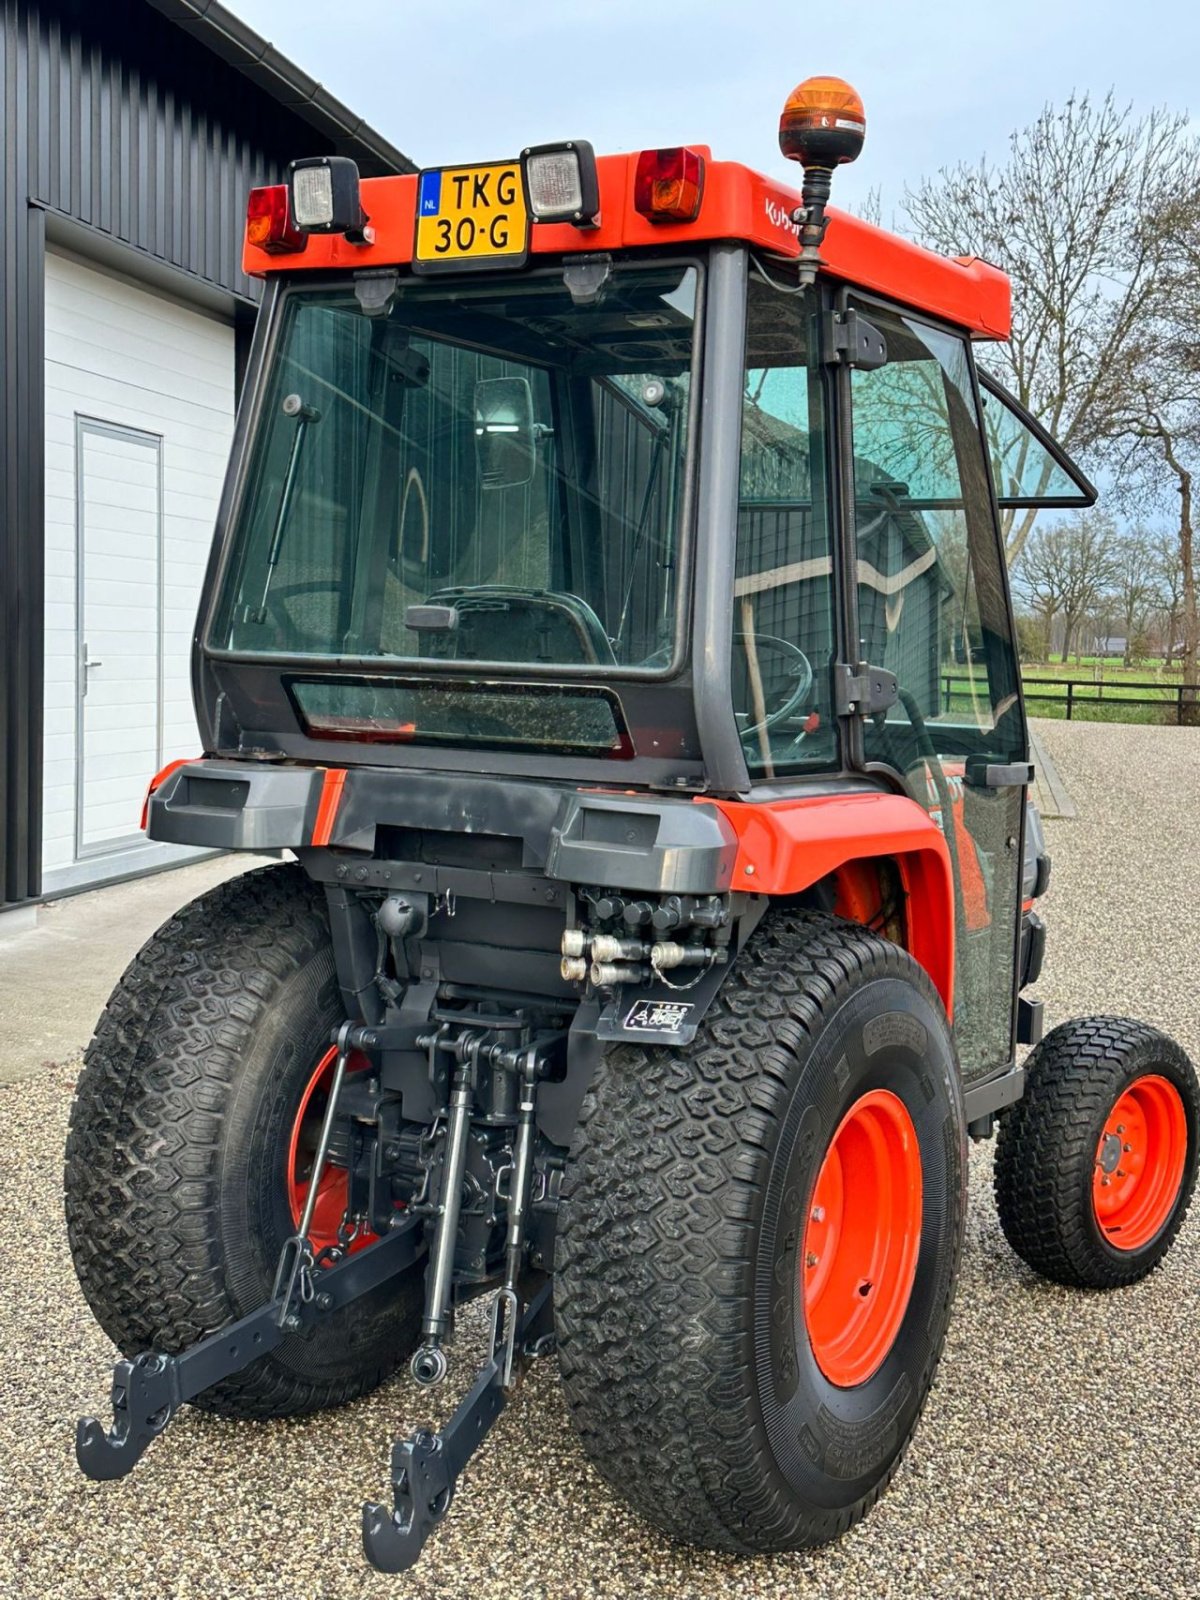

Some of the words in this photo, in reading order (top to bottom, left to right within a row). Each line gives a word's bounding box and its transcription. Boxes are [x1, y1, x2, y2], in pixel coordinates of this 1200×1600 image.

[424, 199, 436, 210] NL
[453, 171, 515, 209] TKG
[435, 214, 509, 253] 30-G
